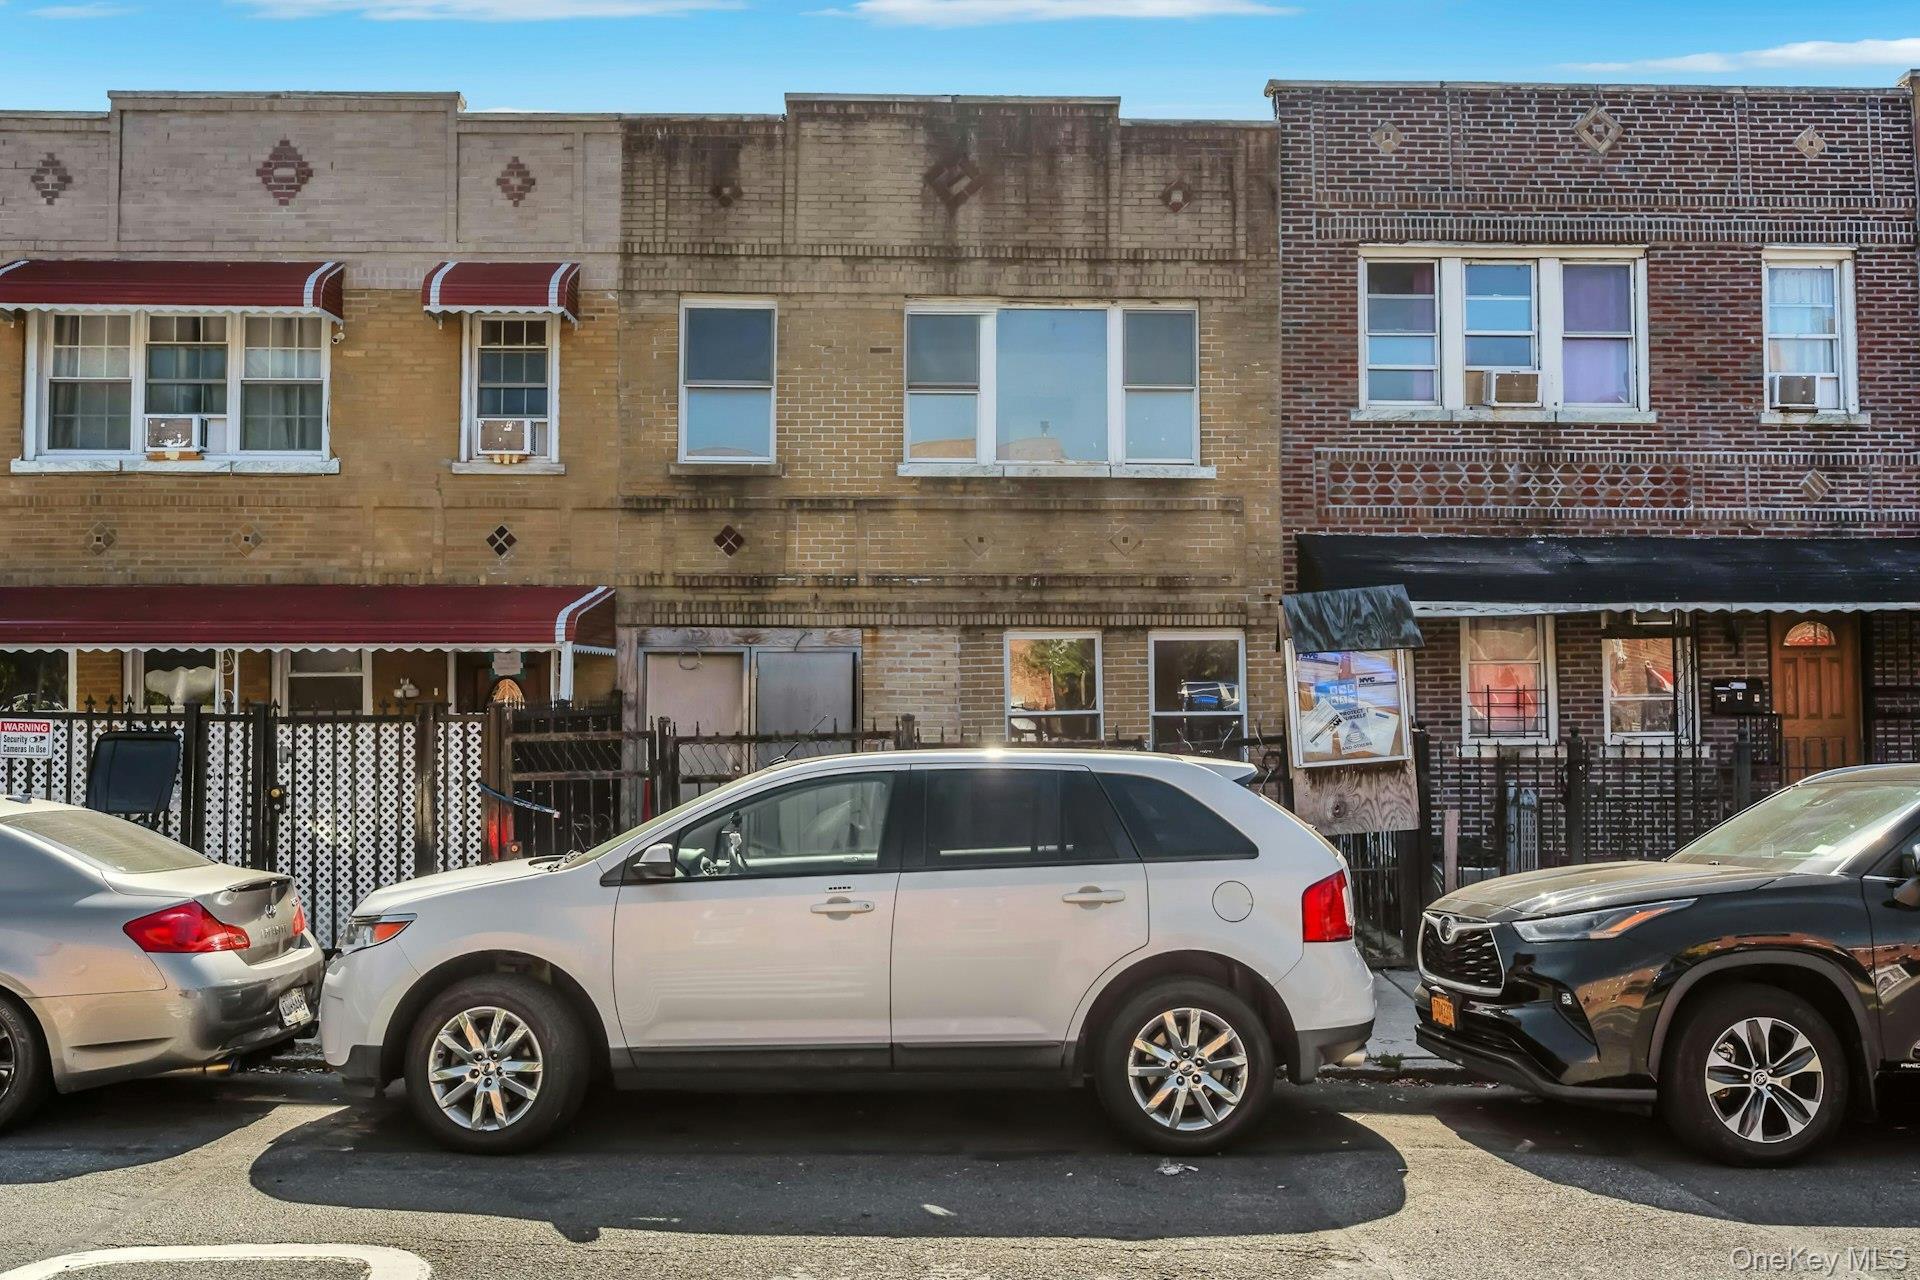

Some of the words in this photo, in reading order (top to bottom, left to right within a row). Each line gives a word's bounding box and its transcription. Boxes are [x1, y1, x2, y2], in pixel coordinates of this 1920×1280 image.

[3, 722, 48, 732] WARNING
[3, 734, 28, 745] Security
[3, 744, 28, 753] Cameras
[36, 745, 46, 753] Use
